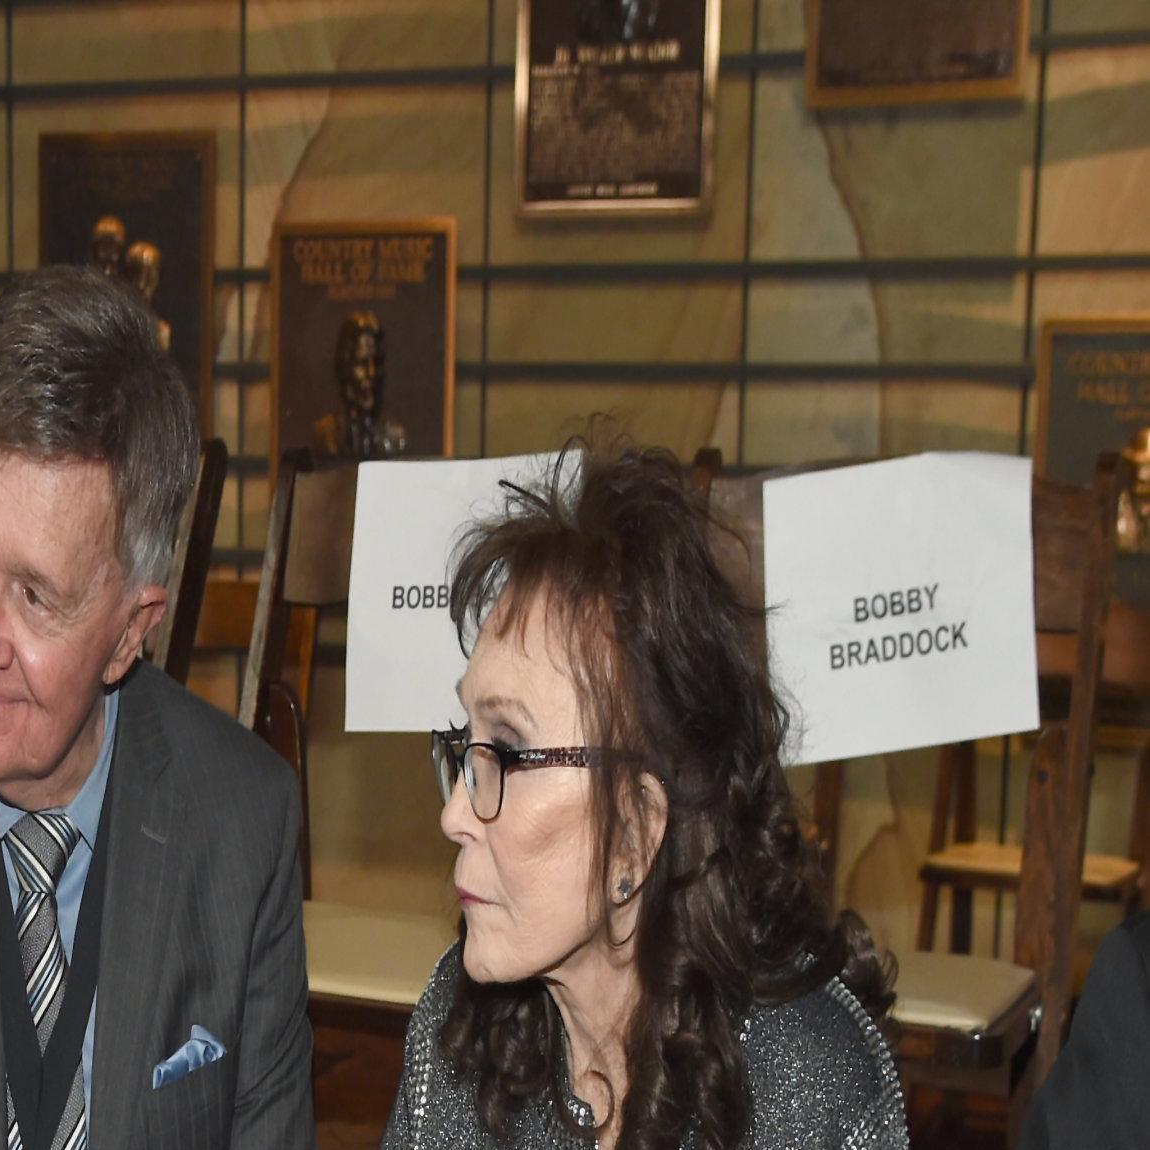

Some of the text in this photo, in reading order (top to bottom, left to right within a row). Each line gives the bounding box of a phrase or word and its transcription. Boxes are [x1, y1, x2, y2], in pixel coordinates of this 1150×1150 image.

[391, 584, 451, 610] BOBB
[853, 583, 939, 623] BOBBY
[830, 621, 968, 670] BRADDOCK
